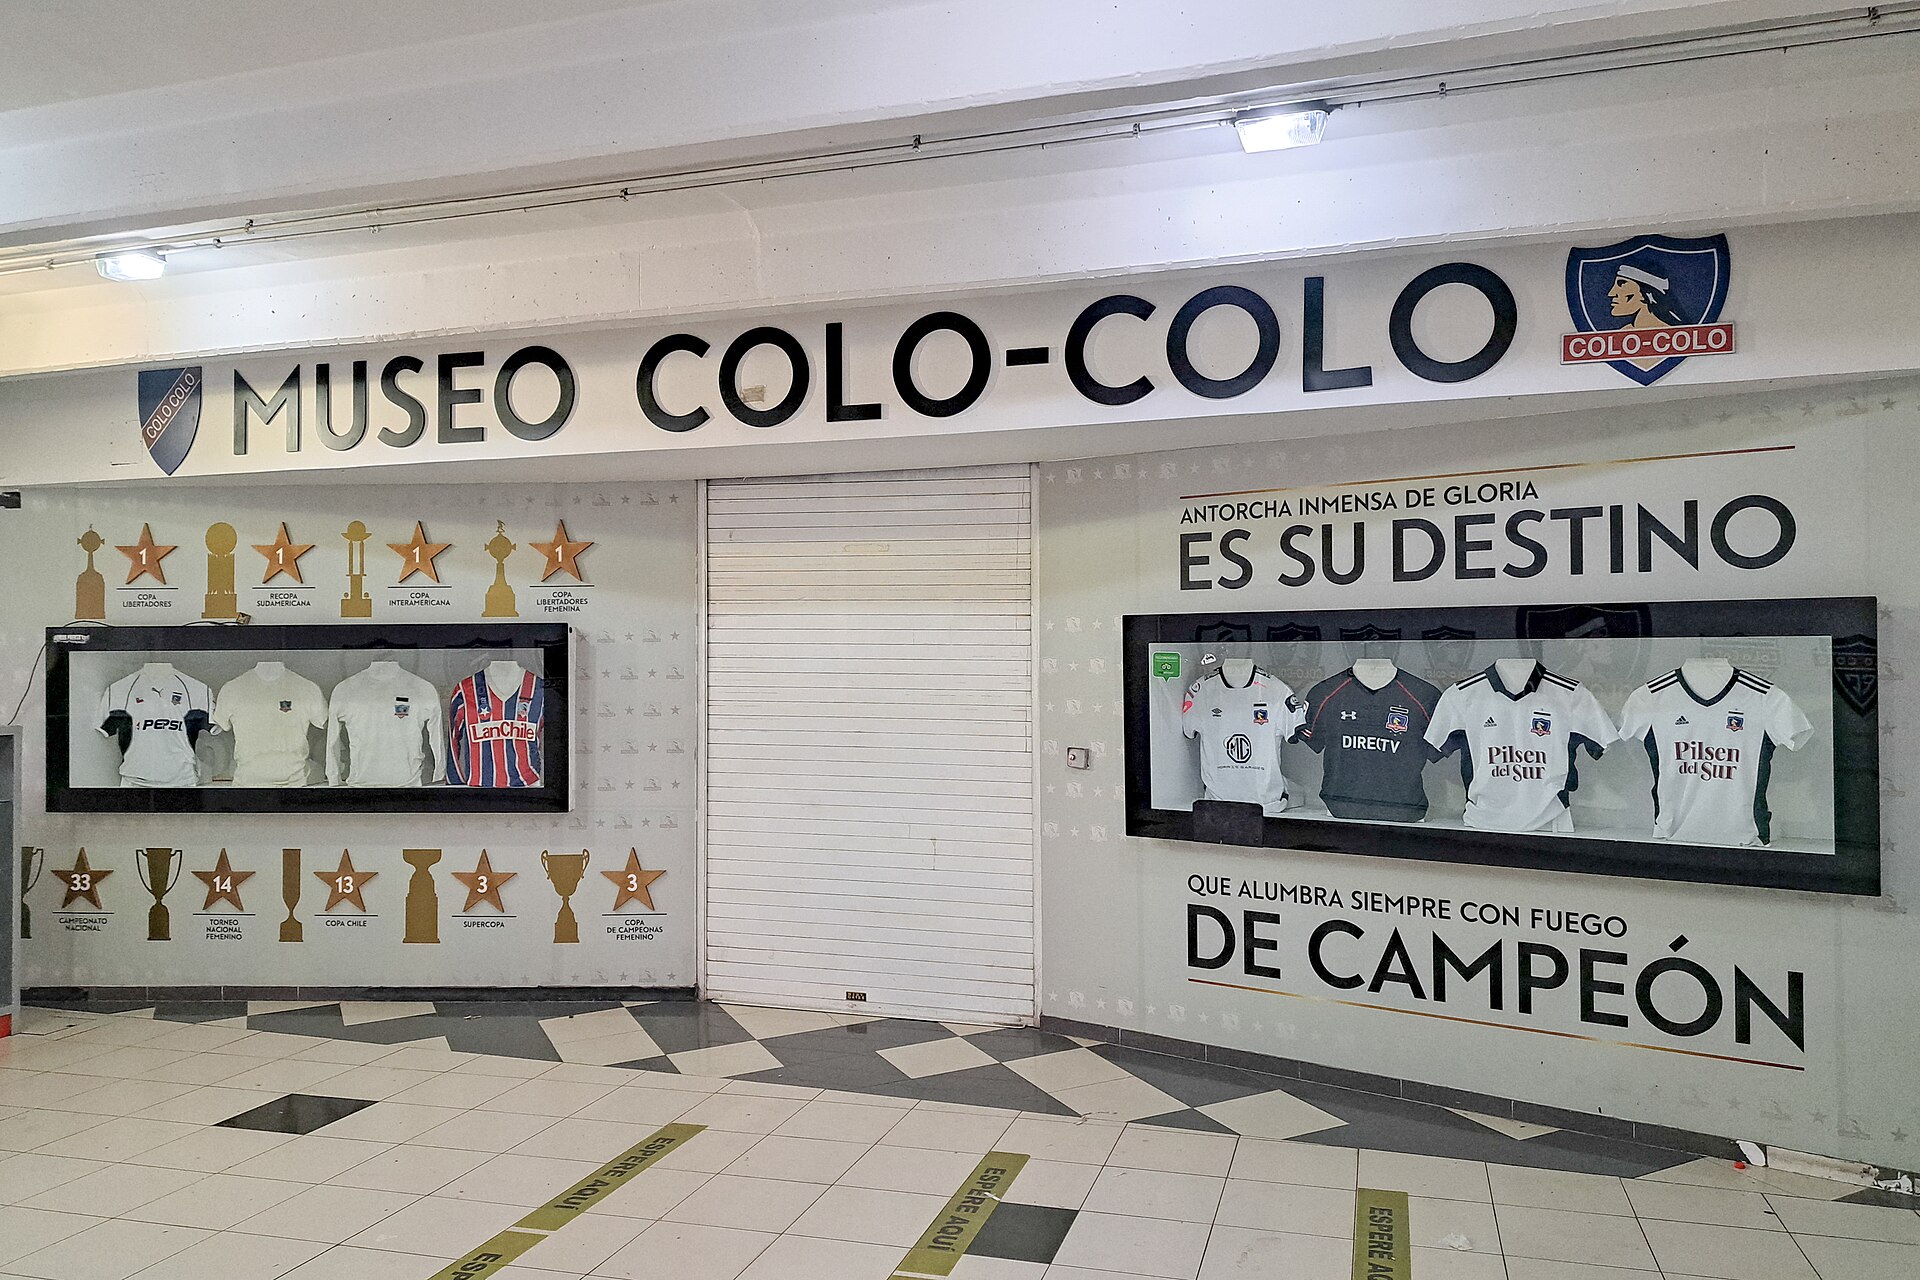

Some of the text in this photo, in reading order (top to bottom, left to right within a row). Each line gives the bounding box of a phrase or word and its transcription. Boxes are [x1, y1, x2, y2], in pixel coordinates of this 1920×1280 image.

[1568, 328, 1727, 358] COLO-COLO
[234, 261, 1518, 456] MUSEO COLO-COLO
[146, 373, 195, 439] COLO COLO
[1180, 481, 1539, 524] ANTORCHA INMENSA DE GLORIA
[1179, 493, 1797, 590] ES SU DESTINO
[138, 547, 148, 565] 1
[275, 547, 284, 565] 1
[411, 546, 421, 563] 1
[554, 544, 563, 563] 1
[122, 600, 172, 608] LIBERTADORES
[137, 593, 157, 601] COPA
[256, 599, 311, 607] SUDAMERICANA
[269, 592, 298, 600] RECOPA
[388, 598, 451, 607] INTERAMERICANA
[536, 598, 588, 606] LIBERTADORES
[543, 605, 581, 613] FEMENINA
[471, 721, 535, 741] LanChile
[1342, 735, 1400, 754] DIRECTV
[1674, 741, 1740, 763] Pilsen
[1488, 745, 1547, 764] Pilsen
[1491, 764, 1546, 782] del Sur
[1678, 762, 1737, 781] del Sur
[70, 873, 91, 891] 33
[212, 875, 232, 893] 14
[335, 876, 354, 894] 13
[476, 875, 488, 894] 3
[626, 873, 639, 892] 3
[1187, 874, 1628, 938] QUE ALUMBRA SIEMPRE CON FUEGO
[58, 917, 108, 925] CAMPEONATO
[65, 924, 102, 932] NACIONAL
[206, 925, 242, 933] NACIONAL
[325, 919, 367, 928] COPA CHILE
[463, 920, 505, 929] SUPERCOPA
[606, 926, 616, 934] DE
[206, 932, 243, 941] FEMENINO
[616, 933, 654, 941] FEMENINO
[1187, 903, 1805, 1054] DE CAMPEÓN
[602, 1137, 676, 1178] ESPERE
[927, 1166, 1007, 1253] ESPERE AQUÍ
[1368, 1206, 1394, 1260] ESPERE
